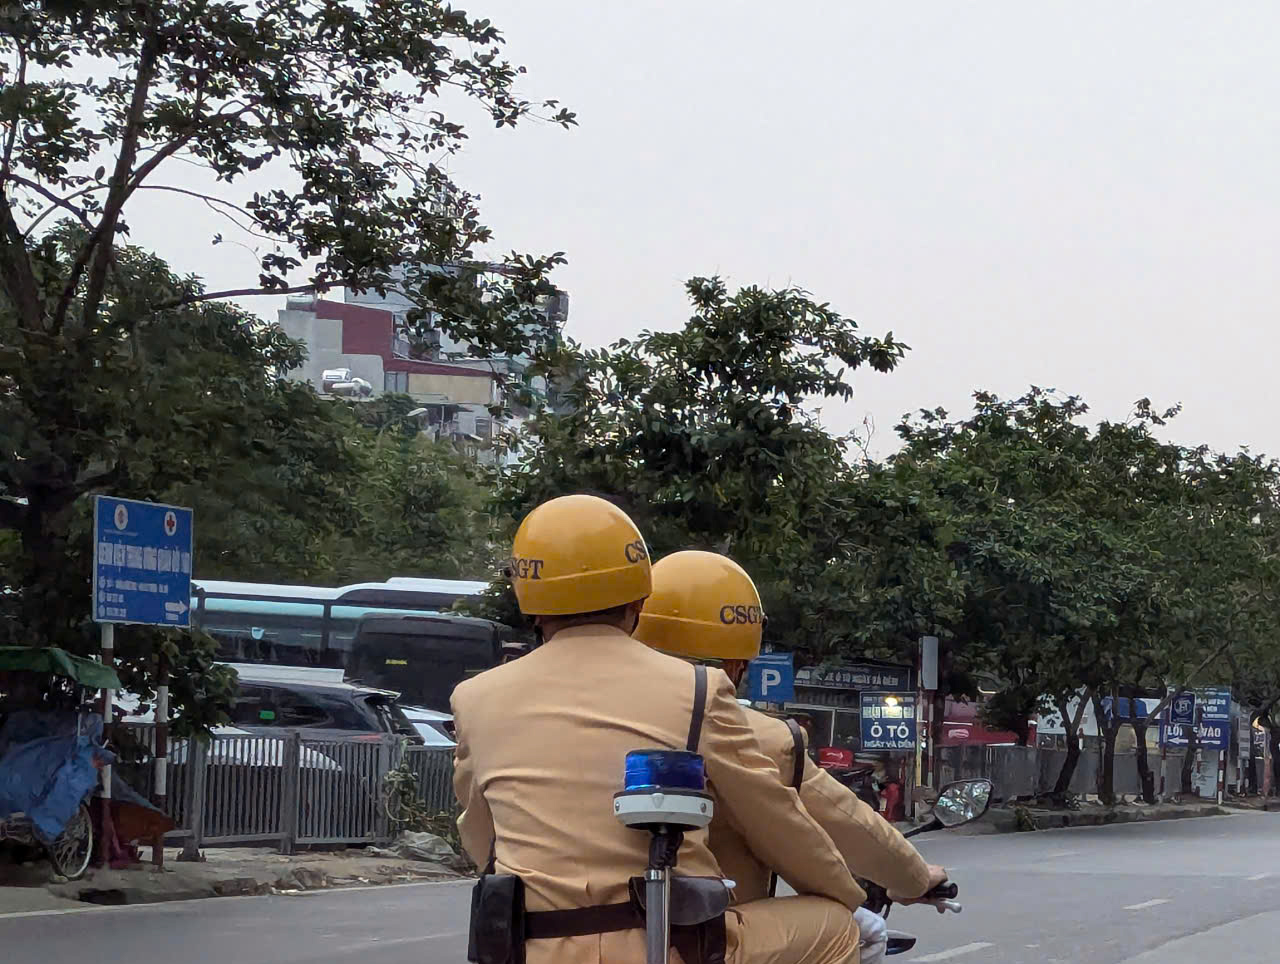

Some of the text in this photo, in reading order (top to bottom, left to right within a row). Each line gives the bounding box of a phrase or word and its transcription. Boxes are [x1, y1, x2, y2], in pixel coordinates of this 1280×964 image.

[761, 668, 782, 696] P
[870, 721, 910, 739] Ô TÔ
